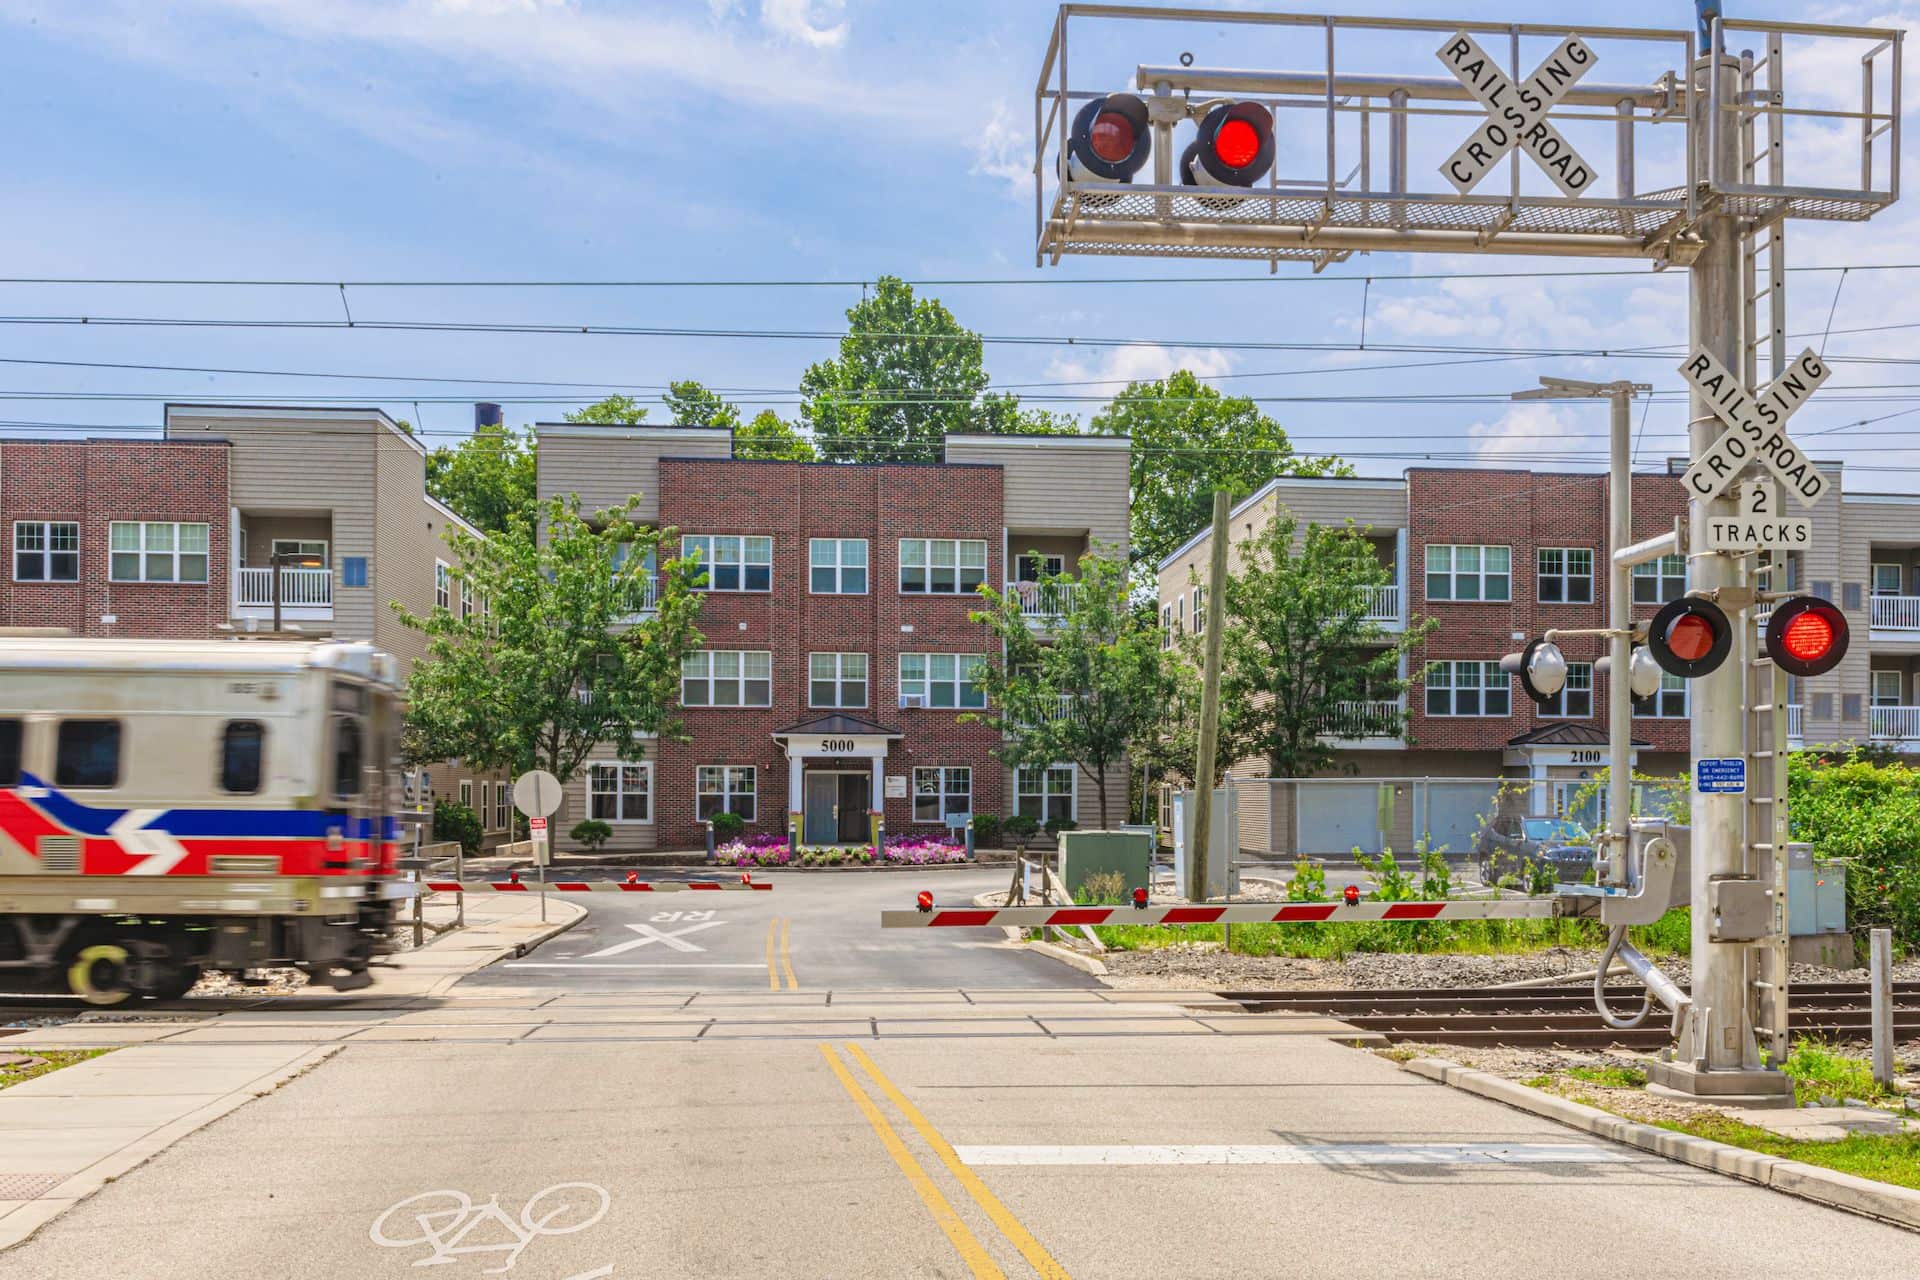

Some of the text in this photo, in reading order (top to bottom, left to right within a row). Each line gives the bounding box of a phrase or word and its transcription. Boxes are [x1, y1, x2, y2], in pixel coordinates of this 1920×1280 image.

[1451, 42, 1588, 183] CROSSING
[1692, 357, 1822, 494] CROSSING
[1752, 490, 1767, 513] 2
[1713, 524, 1807, 542] TRACKS
[821, 740, 854, 752] 5000
[1570, 751, 1600, 763] 2100
